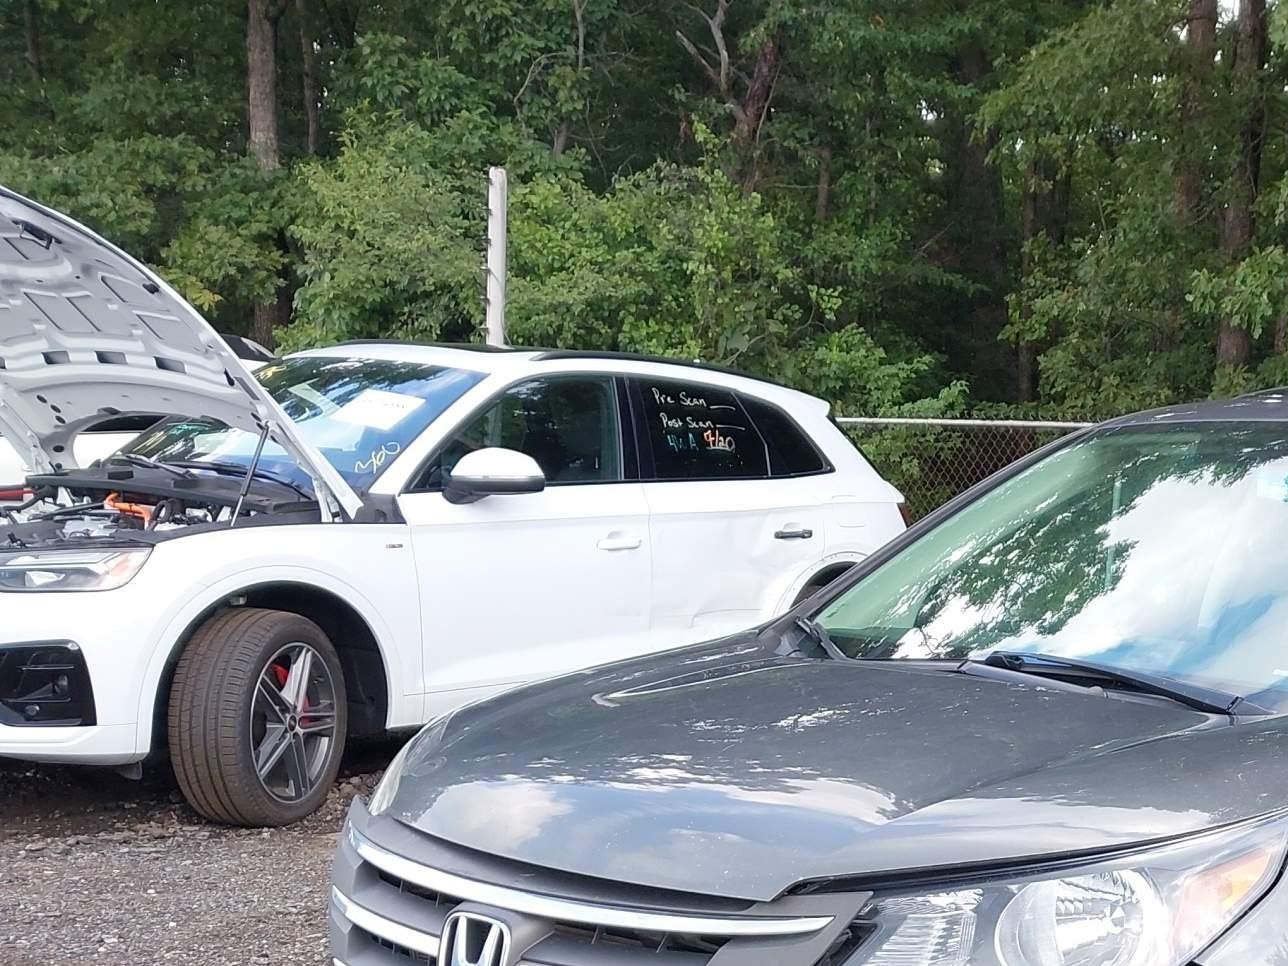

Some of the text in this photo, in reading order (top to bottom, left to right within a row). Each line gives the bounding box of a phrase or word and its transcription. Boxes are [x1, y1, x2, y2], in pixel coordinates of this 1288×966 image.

[652, 387, 708, 407] Pre Scan
[659, 412, 714, 429] Post Scan
